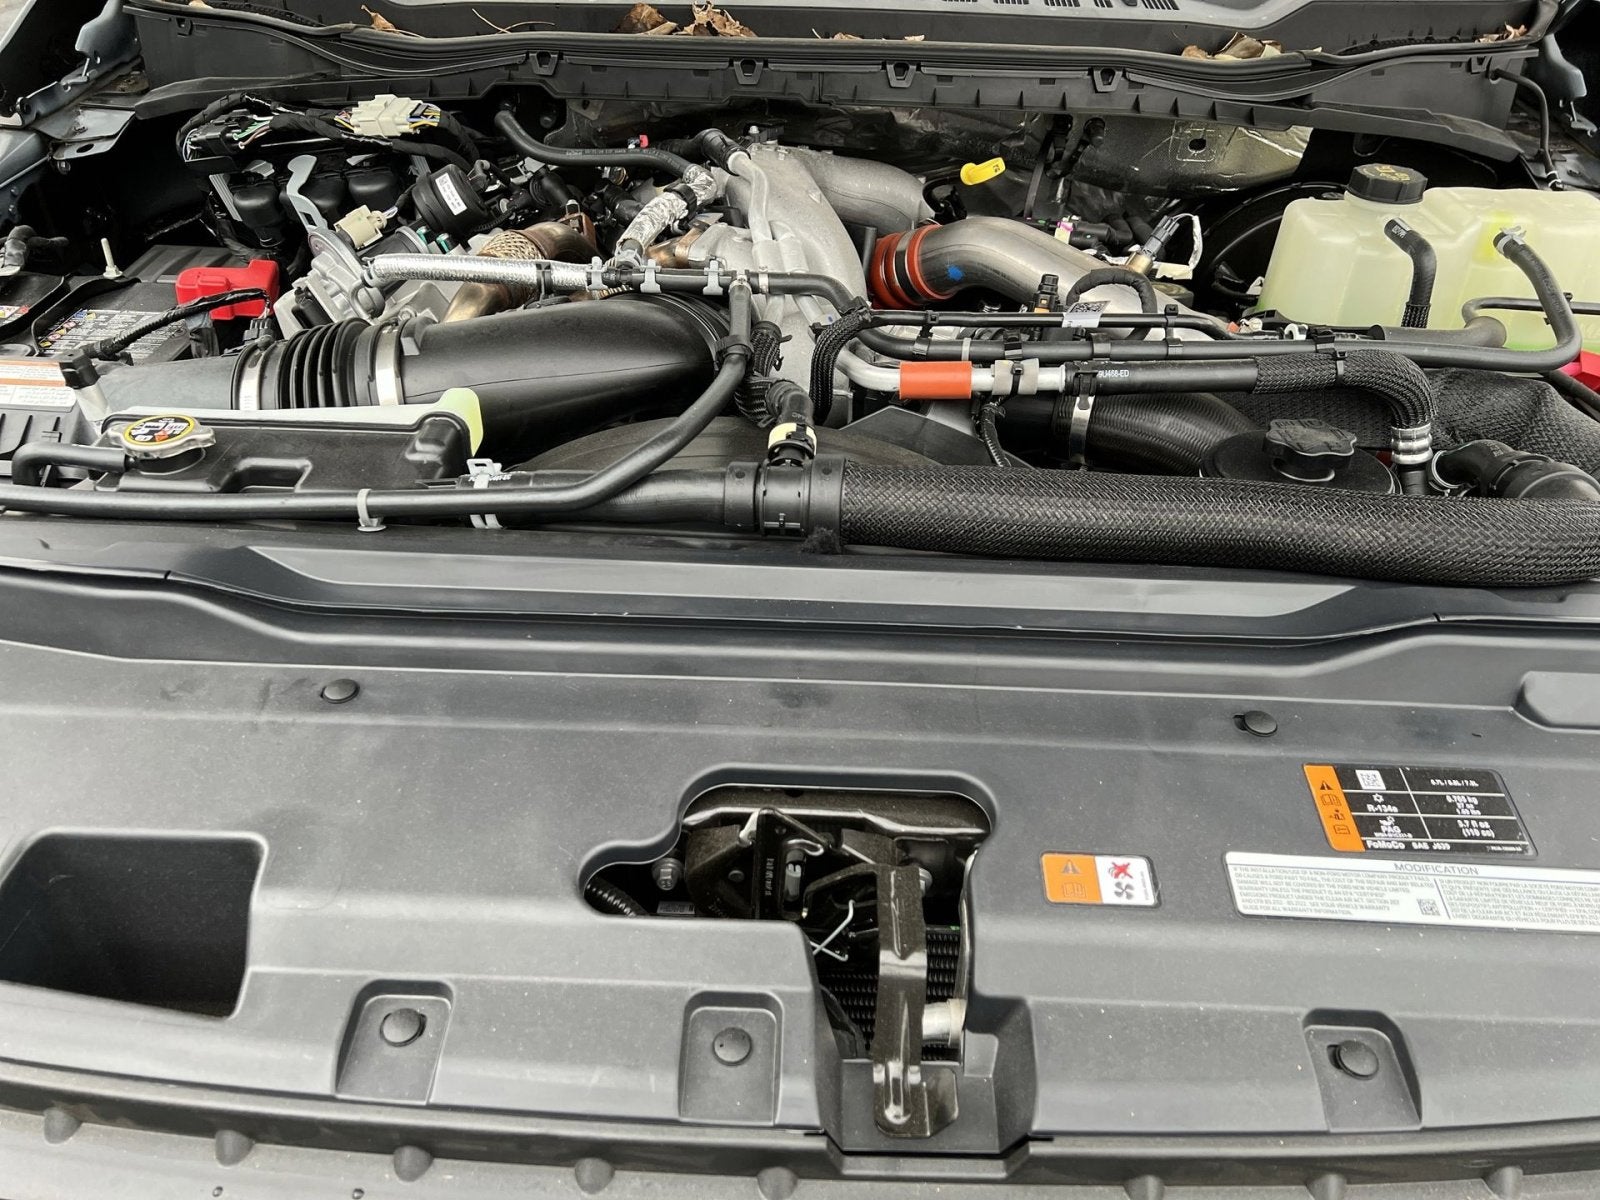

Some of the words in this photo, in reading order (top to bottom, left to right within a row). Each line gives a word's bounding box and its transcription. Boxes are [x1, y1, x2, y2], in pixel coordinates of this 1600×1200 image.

[1366, 804, 1399, 813] R-134a
[1380, 825, 1401, 833] PAG
[1366, 840, 1406, 849] FoMoCo
[1394, 863, 1479, 875] MODIFICATION
